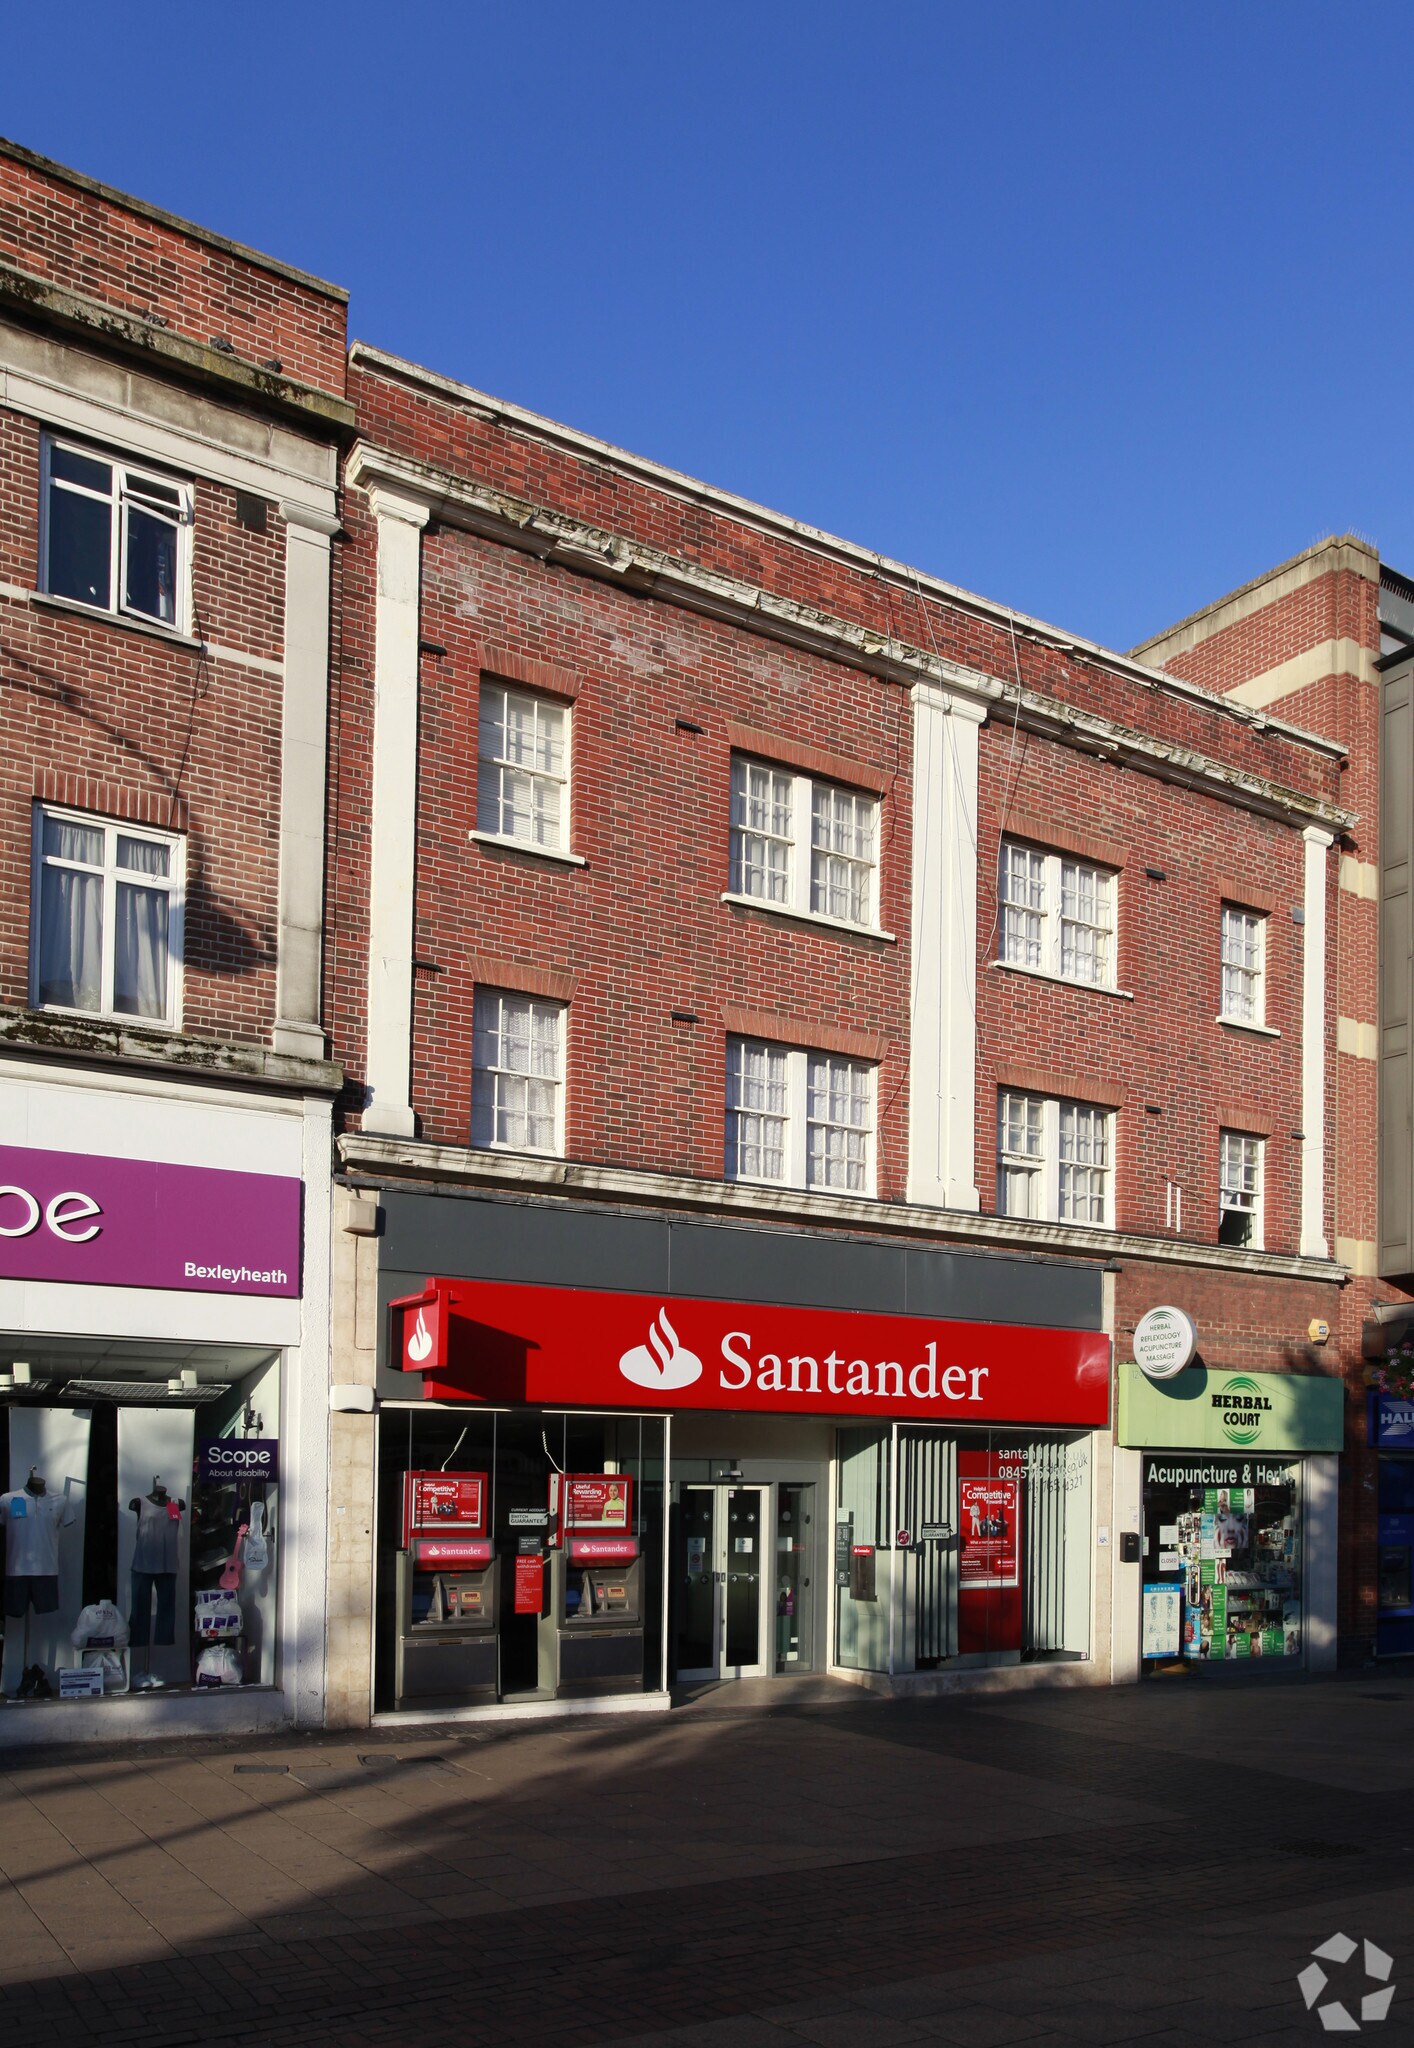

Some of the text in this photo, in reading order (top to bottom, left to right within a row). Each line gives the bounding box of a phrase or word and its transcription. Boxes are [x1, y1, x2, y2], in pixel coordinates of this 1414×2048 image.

[184, 1261, 288, 1285] Bexleyheath
[1149, 1322, 1172, 1332] HERBAL
[1140, 1331, 1181, 1343] REFLEXOLOGY
[1139, 1341, 1182, 1353] ACUPUNCTURE
[1146, 1352, 1175, 1363] MASSAGE
[719, 1331, 989, 1401] Santander
[1211, 1394, 1272, 1411] HERBAL
[1223, 1412, 1261, 1427] COURT
[207, 1446, 271, 1468] Scope
[208, 1468, 271, 1480] About disability
[998, 1466, 1027, 1479] 0845
[1147, 1462, 1238, 1488] Acupuncture
[1241, 1463, 1252, 1484] &
[419, 1485, 456, 1494] Competitive
[572, 1488, 602, 1497] Rewarding
[966, 1490, 1012, 1502] Competitive
[441, 1546, 482, 1557] Santander
[591, 1543, 628, 1555] Santander
